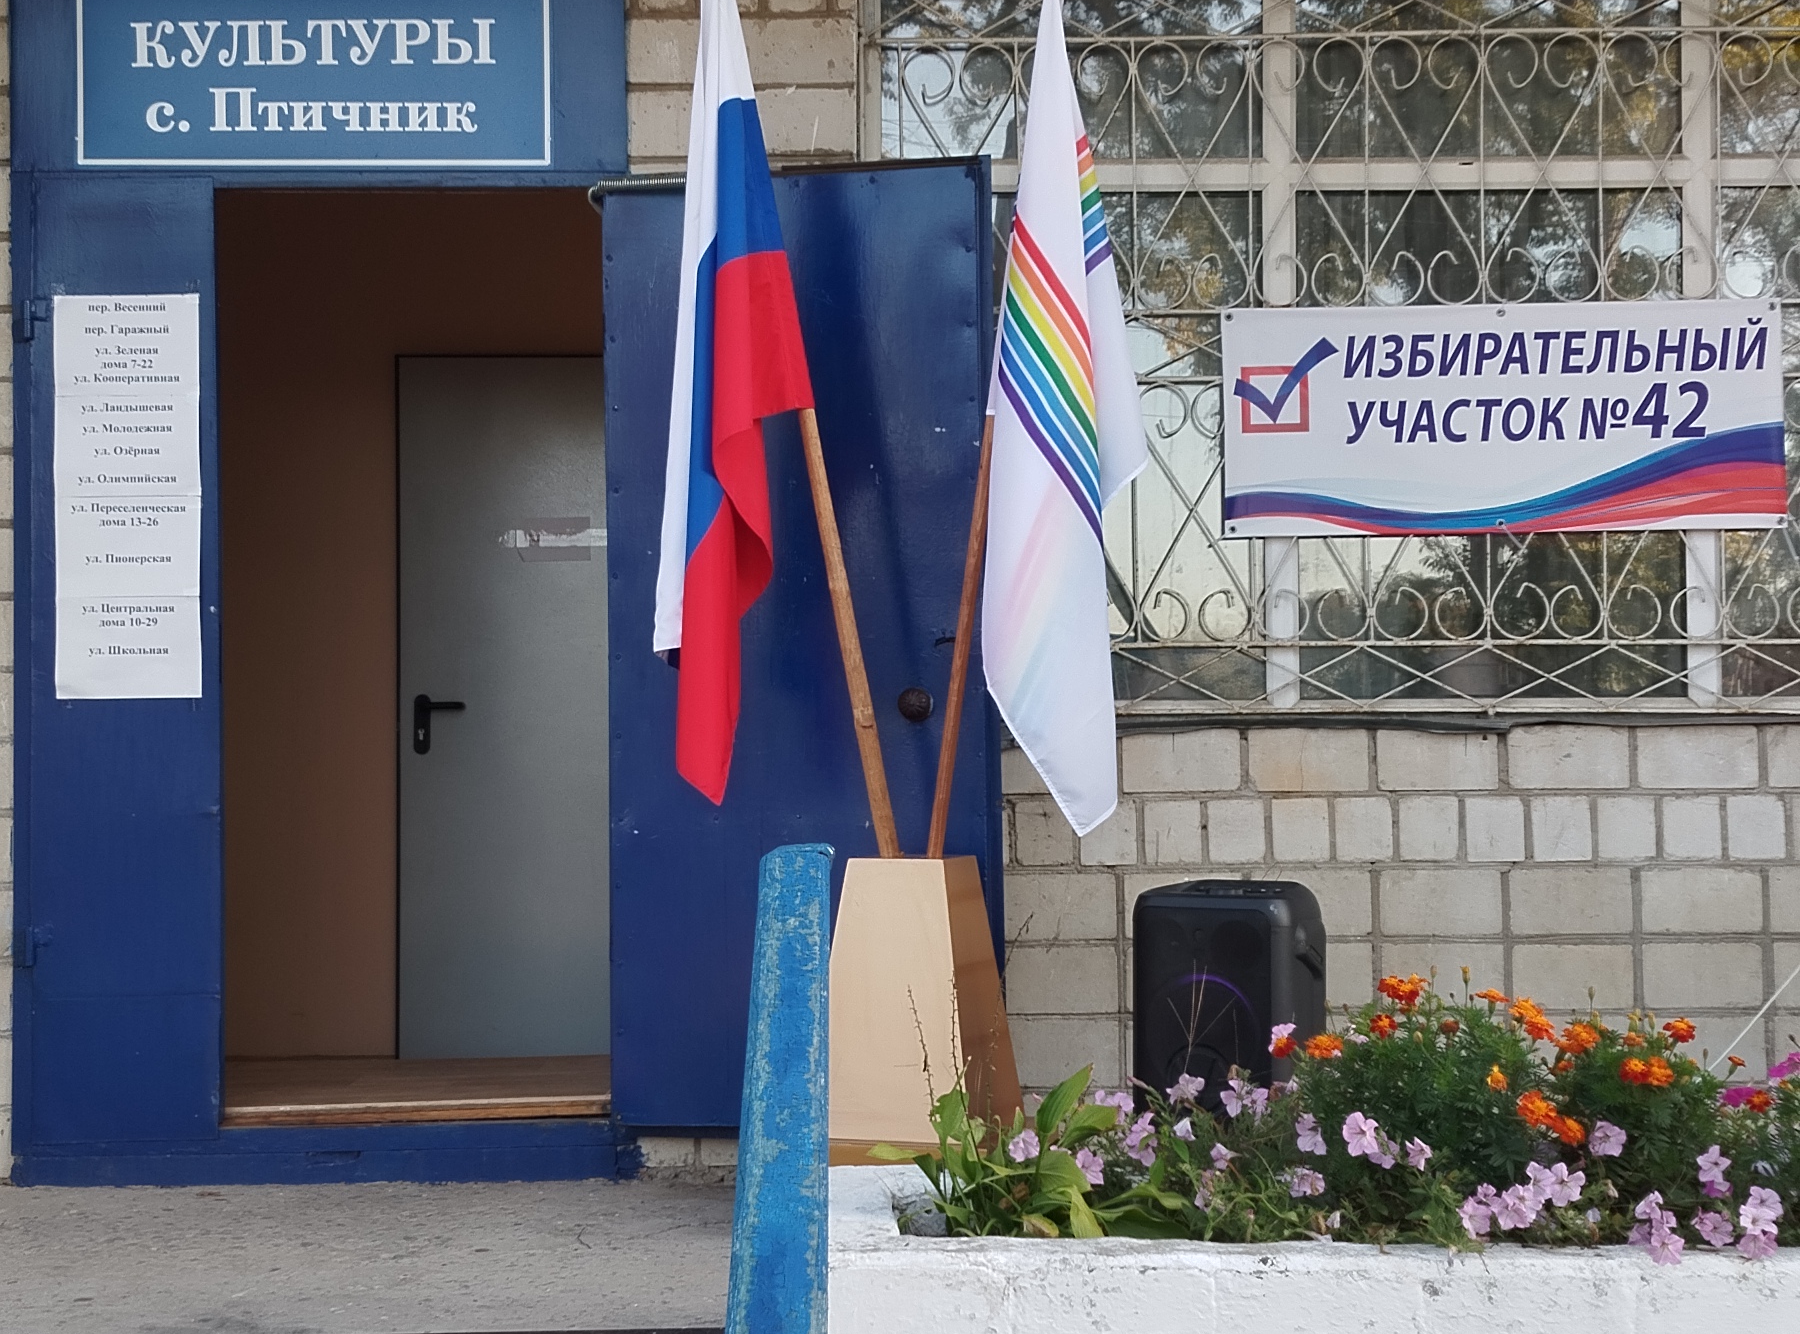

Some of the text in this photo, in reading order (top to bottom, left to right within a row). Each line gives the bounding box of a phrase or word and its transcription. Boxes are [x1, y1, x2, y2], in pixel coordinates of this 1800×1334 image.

[131, 18, 496, 68] КУЛЬТУРЫ
[146, 87, 477, 132] с. Птичник
[88, 302, 166, 313] пер. Весенний
[85, 325, 169, 336] пер. Гаражный
[95, 345, 159, 357] ул. Зеленая
[1343, 317, 1769, 379] ИЗБИРАТЕЛЬНЫЙ
[100, 359, 153, 369] дома 7-22
[74, 374, 180, 385] ул. Кооперативная
[81, 403, 173, 414] ул. Ландышевая
[1346, 396, 1570, 445] УЧАСТОК
[82, 424, 172, 435] ул. Молодежная
[94, 445, 160, 457] ул. Озёрная
[78, 474, 177, 485] ул. Олимпийская
[71, 503, 186, 514] ул. Переселенческая
[99, 517, 159, 527] дома 13-26
[85, 554, 172, 565] ул. Пионерская
[82, 604, 175, 615] ул. Центральная
[99, 618, 158, 627] дома 10-29
[89, 646, 169, 656] ул. Школьная
